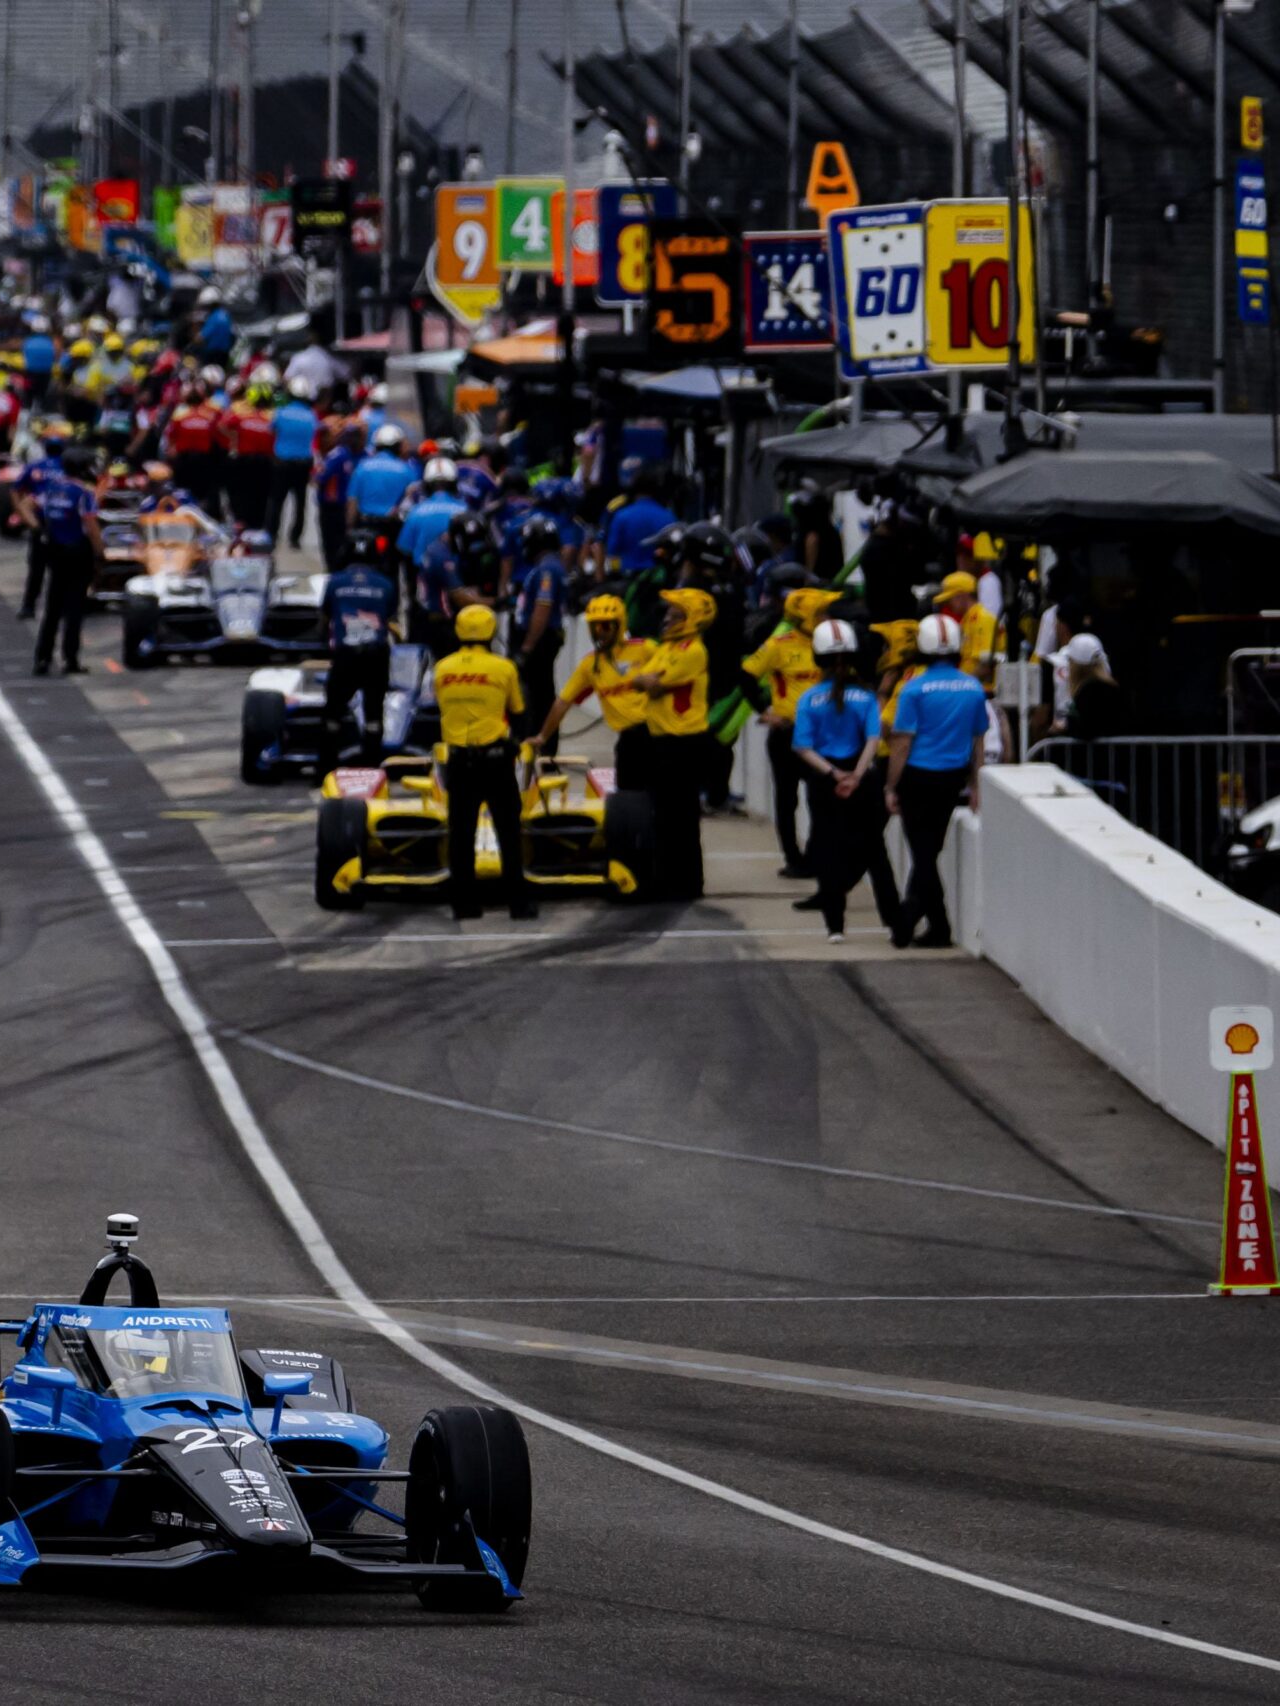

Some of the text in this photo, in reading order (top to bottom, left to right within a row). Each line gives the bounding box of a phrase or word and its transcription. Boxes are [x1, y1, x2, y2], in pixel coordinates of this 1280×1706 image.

[453, 220, 487, 280] 9
[510, 197, 549, 251] 4
[617, 223, 650, 293] 8
[655, 236, 729, 342] 5
[763, 262, 822, 320] 14
[856, 263, 920, 317] 60
[941, 258, 1010, 349] 10
[1237, 1098, 1260, 1260] PIT ZONE
[122, 1316, 212, 1328] ANDRETTI
[272, 1359, 320, 1369] VIZIO
[174, 1428, 258, 1454] 27
